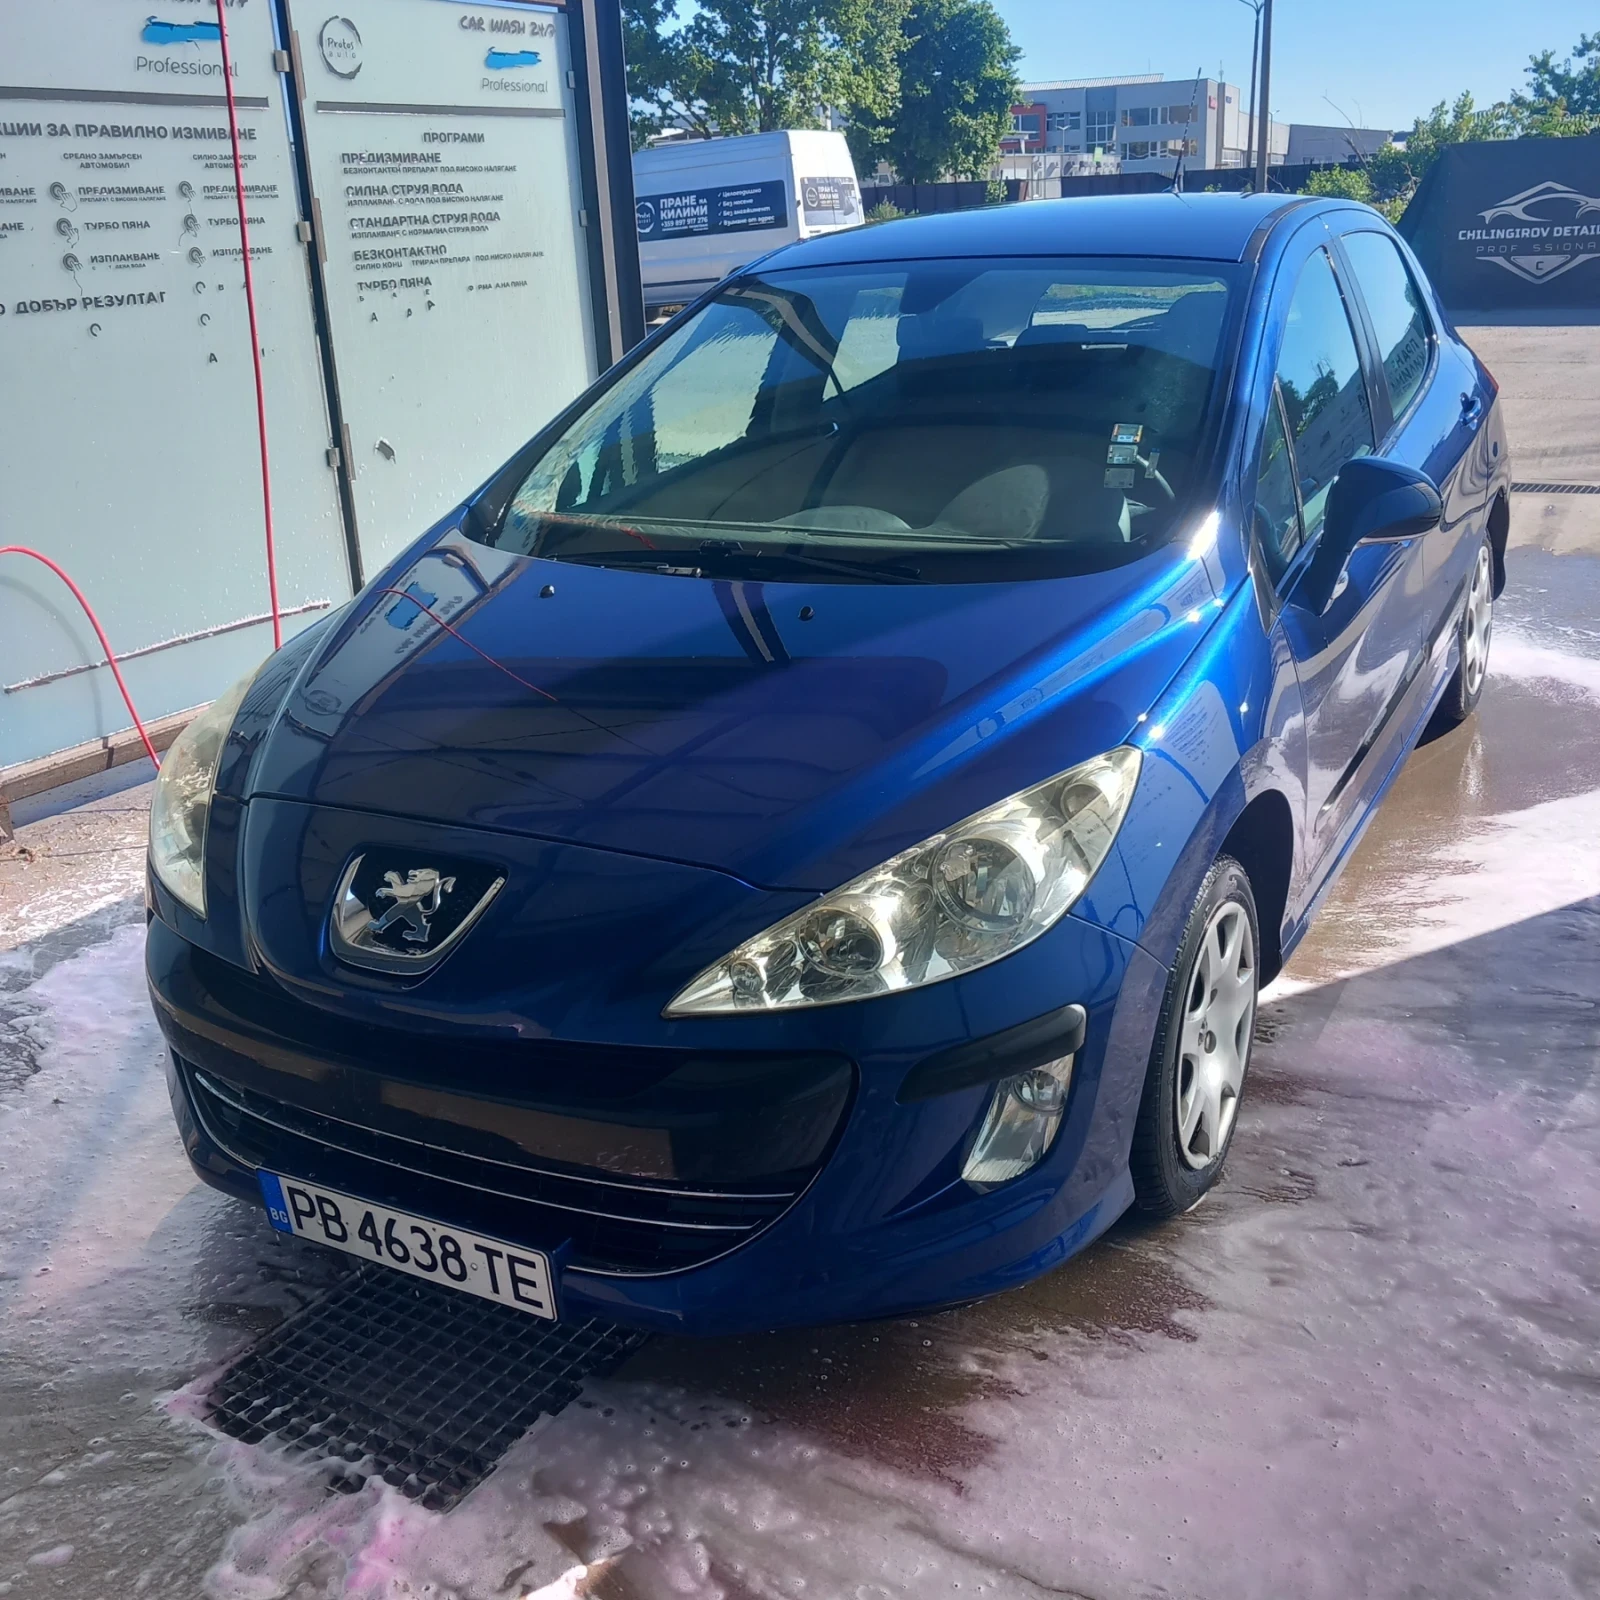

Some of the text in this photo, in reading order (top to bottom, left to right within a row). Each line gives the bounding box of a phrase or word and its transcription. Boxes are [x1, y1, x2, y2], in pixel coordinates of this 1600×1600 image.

[460, 15, 556, 37] CAR WASH 24/7
[327, 37, 354, 50] Protos
[482, 77, 548, 93] Professional
[46, 123, 72, 137] ЗА
[75, 124, 168, 139] ПРАВИЛНО
[423, 132, 485, 143] ПРОГРАМИ
[63, 152, 97, 160] СРЕДНО
[341, 152, 442, 164] ПРЕДИЗМИВАНЕ
[343, 166, 400, 174] БЕЗКОНТАКТЕН
[456, 165, 483, 173] ВИСОКО
[78, 186, 165, 195] ПРЕДИЗМИВАНЕ
[202, 184, 278, 193] ПРЕДИМИВАНЕ
[345, 183, 464, 197] СИЛНА СТРУЯ ВОДА
[660, 194, 697, 209] ПРАНЕ
[660, 205, 708, 220] КИЛИМИ
[84, 220, 150, 230] ТУРБО ПЯНА
[207, 217, 239, 226] ТУРБО
[350, 211, 501, 228] СТАНДАРТНА СТРУЯ ВОДА
[661, 220, 674, 228] +359
[697, 216, 709, 224] 276
[0, 222, 25, 231] АНЕ
[448, 226, 470, 234] СТРУЯ
[1458, 227, 1550, 240] CHILINGIROV
[212, 246, 273, 256] ИЗПЛАВАНЕ
[353, 244, 447, 261] БЕЗКОНТАКТНО
[90, 252, 161, 263] ИЗПЛАКВАНЕ
[355, 262, 381, 271] СИЛНО
[1536, 261, 1544, 271] C
[400, 276, 432, 288] ПЯНА
[15, 297, 78, 314] ДОБЪР
[81, 291, 166, 310] РЕЗУЛТАТ
[269, 1206, 289, 1224] BG
[286, 1186, 544, 1310] PB 4638 TE
